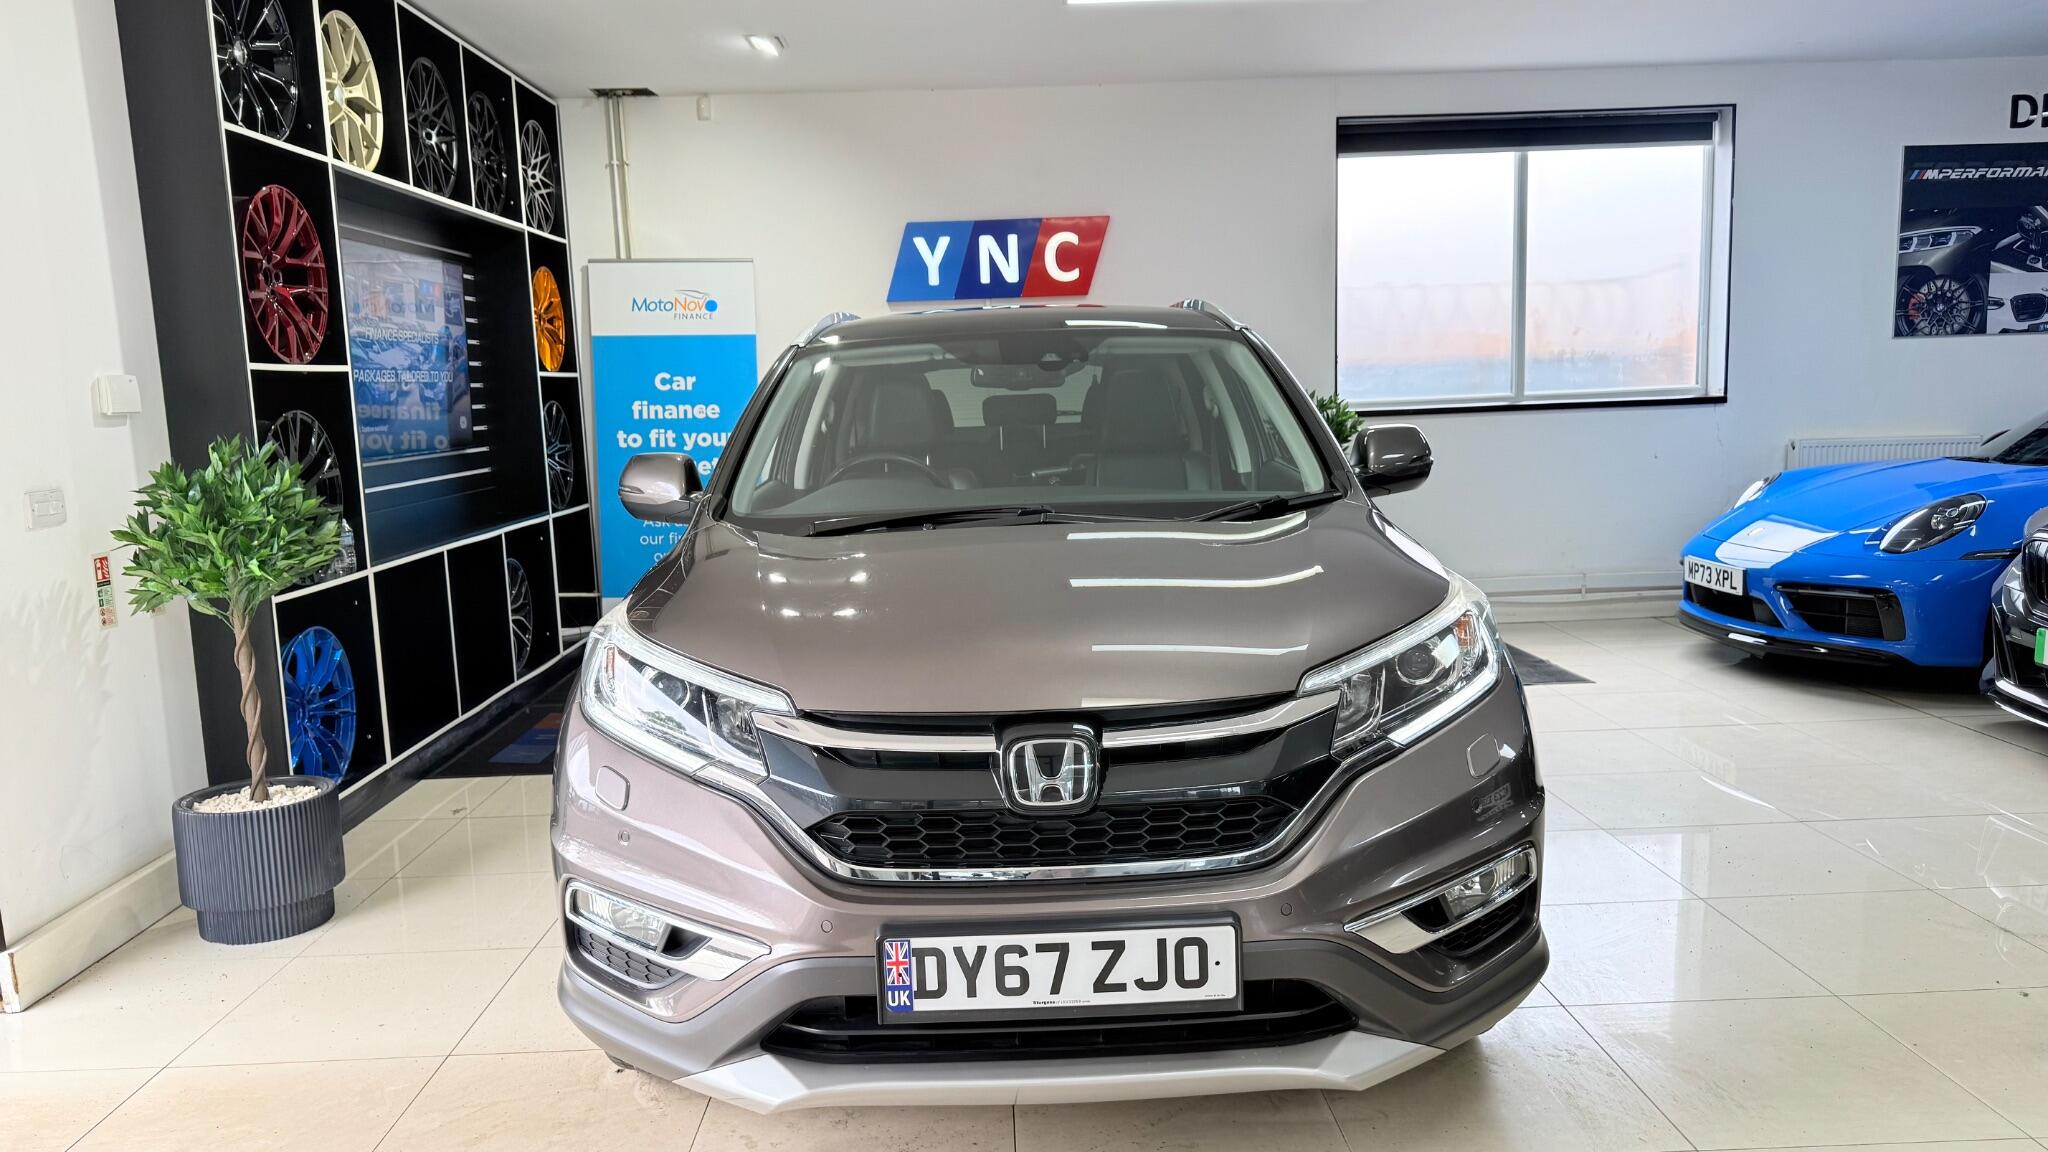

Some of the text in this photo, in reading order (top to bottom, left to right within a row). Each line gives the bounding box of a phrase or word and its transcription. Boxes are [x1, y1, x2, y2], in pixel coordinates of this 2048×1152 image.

[912, 231, 1030, 287] YNC
[673, 313, 713, 321] FINANCE
[365, 328, 398, 342] FINANCE
[353, 368, 396, 383] PACKAGES
[654, 372, 697, 391] Car
[632, 400, 721, 419] finance
[617, 430, 643, 448] to
[649, 429, 676, 448] fit
[640, 535, 664, 545] our
[1688, 561, 1737, 591] MP73 XPL
[911, 936, 1209, 1000] DY67 ZJO
[888, 990, 911, 1007] UK
